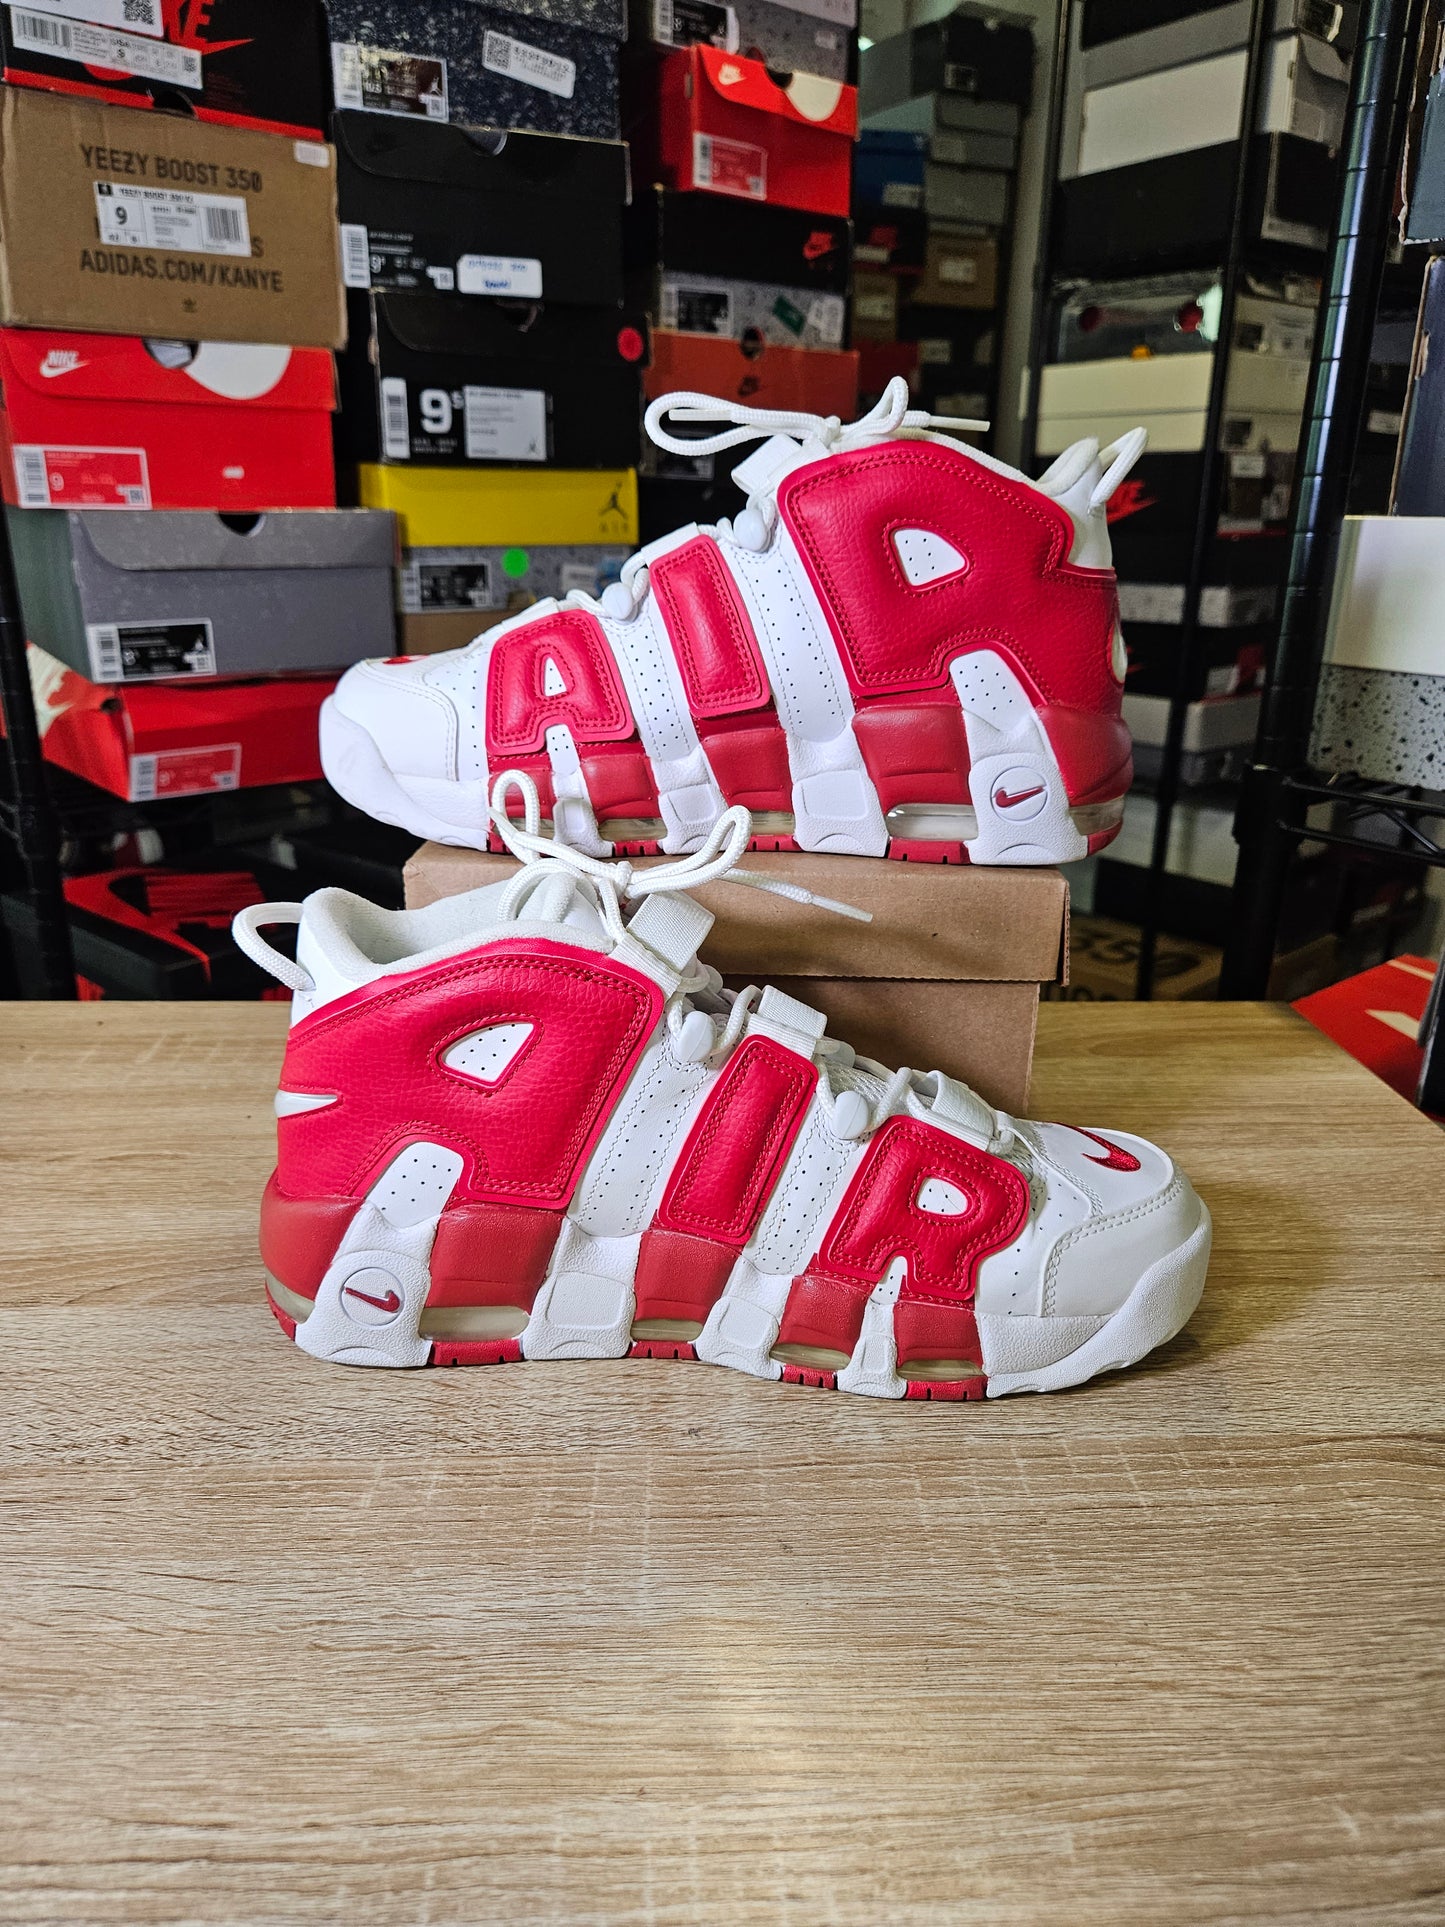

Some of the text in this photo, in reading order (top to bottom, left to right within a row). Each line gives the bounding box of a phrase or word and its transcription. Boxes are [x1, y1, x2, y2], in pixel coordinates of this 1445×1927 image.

[80, 144, 263, 193] YEEZY BOOST 350
[114, 206, 128, 225] 9
[80, 248, 285, 293] ADIDAS.COM/KANYE
[48, 350, 79, 367] NIKE
